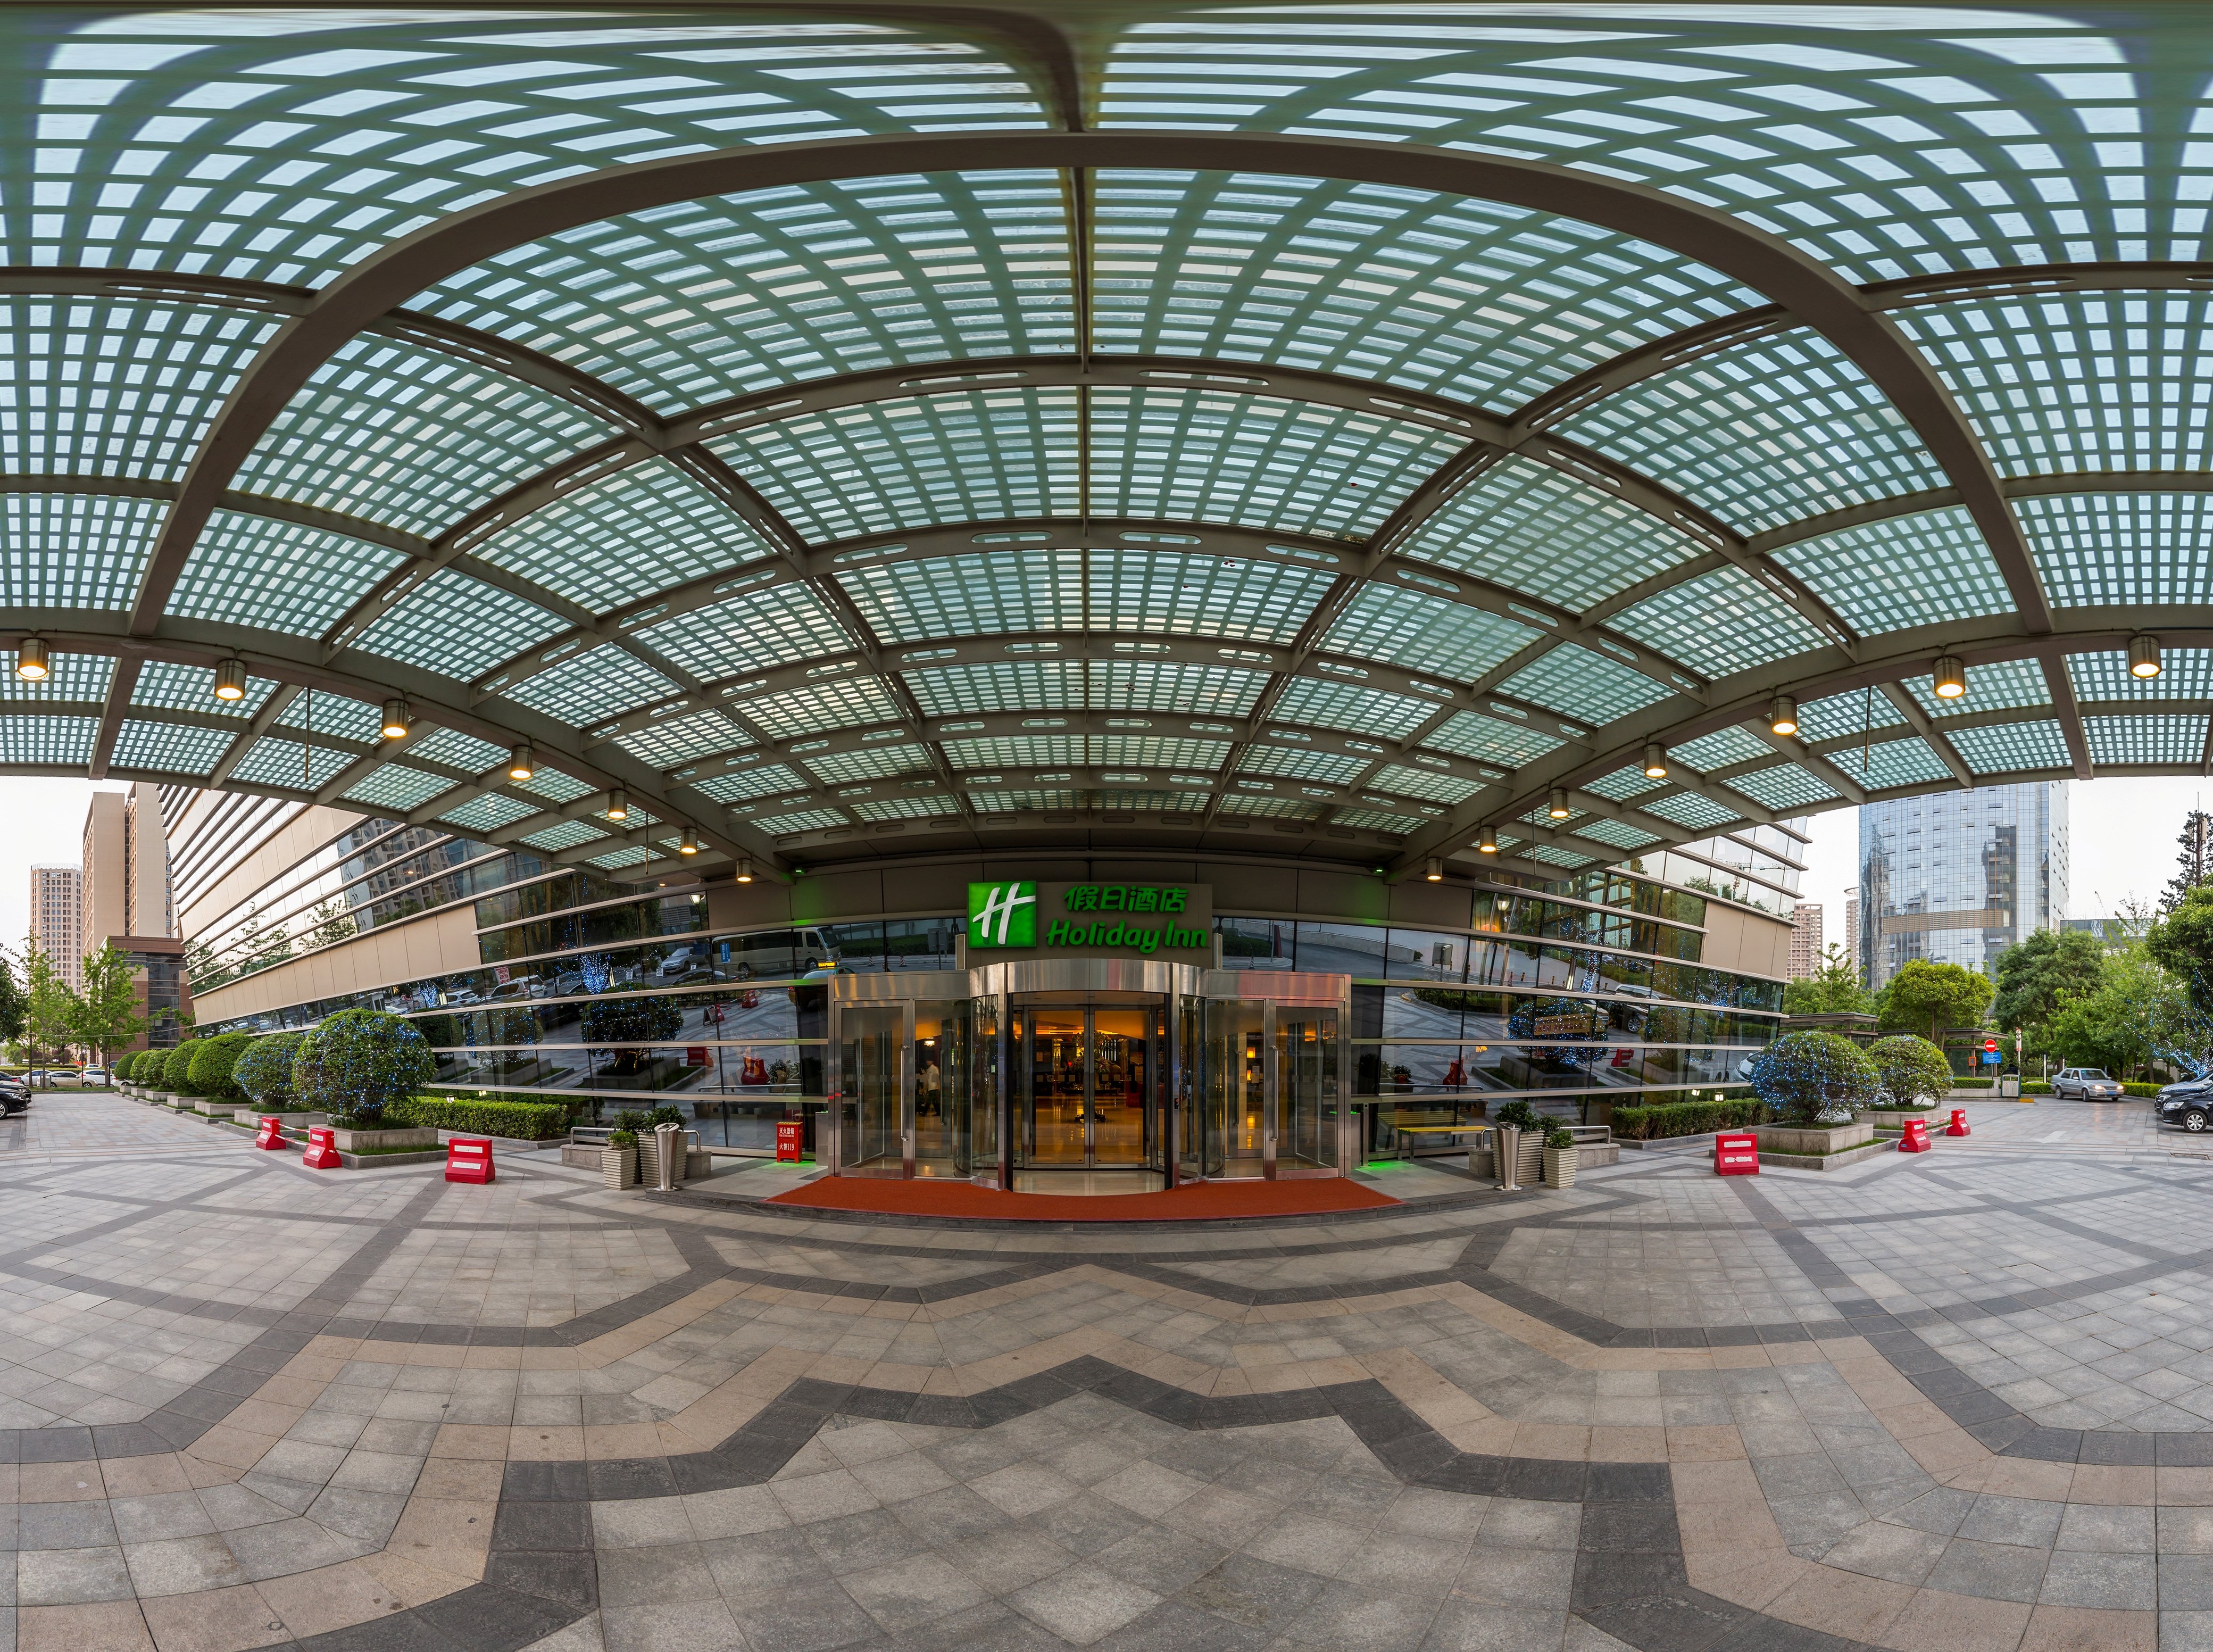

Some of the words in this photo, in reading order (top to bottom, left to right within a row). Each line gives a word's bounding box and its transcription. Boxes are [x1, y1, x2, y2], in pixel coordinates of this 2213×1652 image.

[1064, 885, 1189, 912] 假日酒店
[1046, 919, 1160, 953] Holiday
[1164, 920, 1207, 948] Inn
